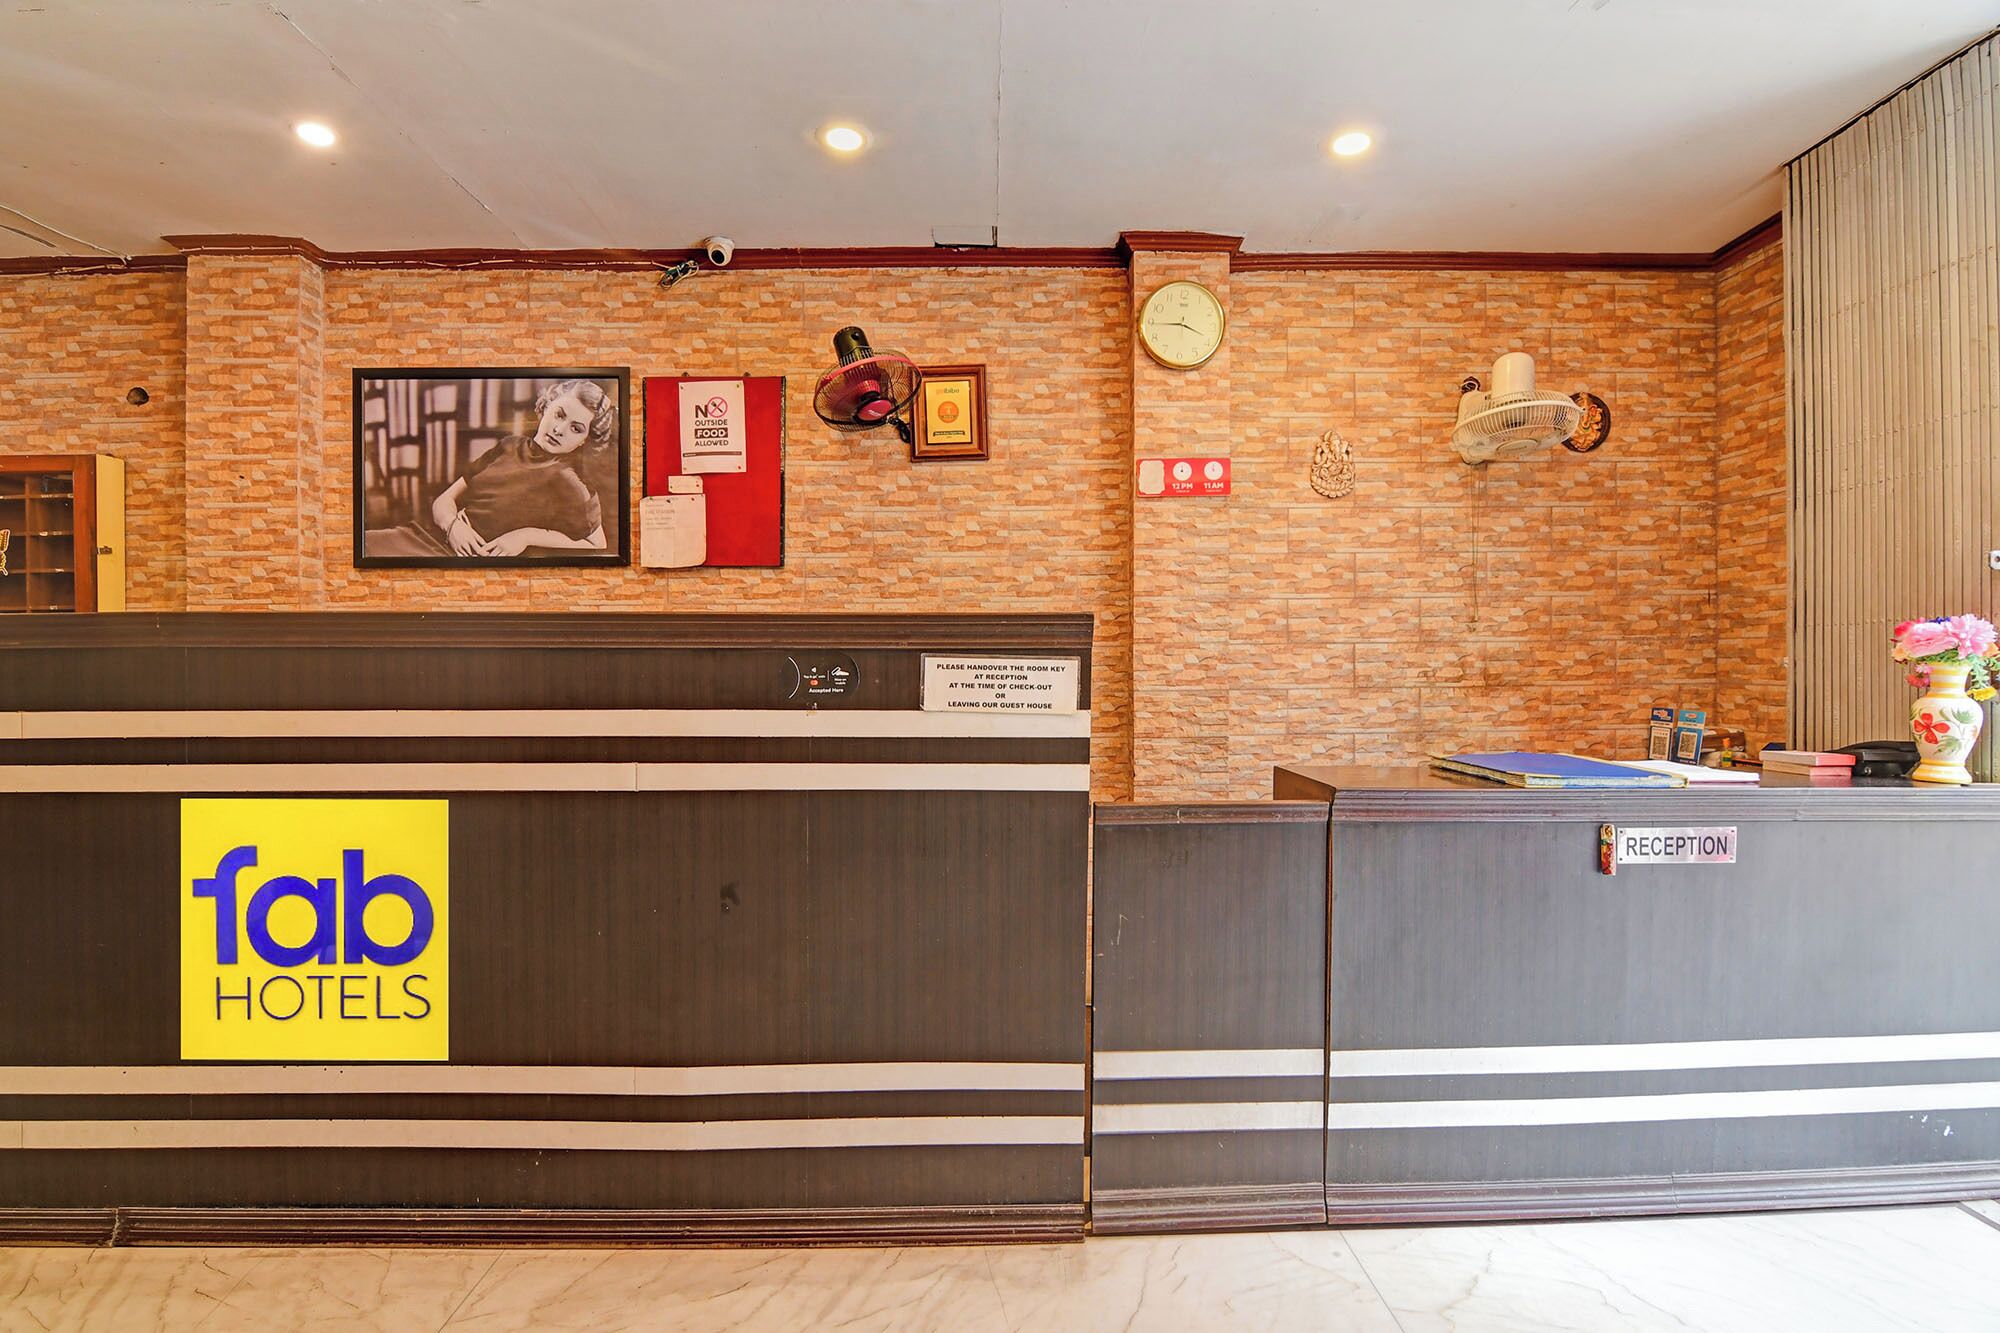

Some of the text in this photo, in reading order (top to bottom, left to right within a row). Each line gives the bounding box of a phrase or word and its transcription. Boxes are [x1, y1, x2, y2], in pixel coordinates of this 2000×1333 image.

[695, 419, 728, 427] OUTSIDE
[696, 428, 727, 438] FOOD
[1626, 836, 1728, 856] RECEPTION
[192, 845, 434, 967] fab
[216, 974, 431, 1021] HOTELS
